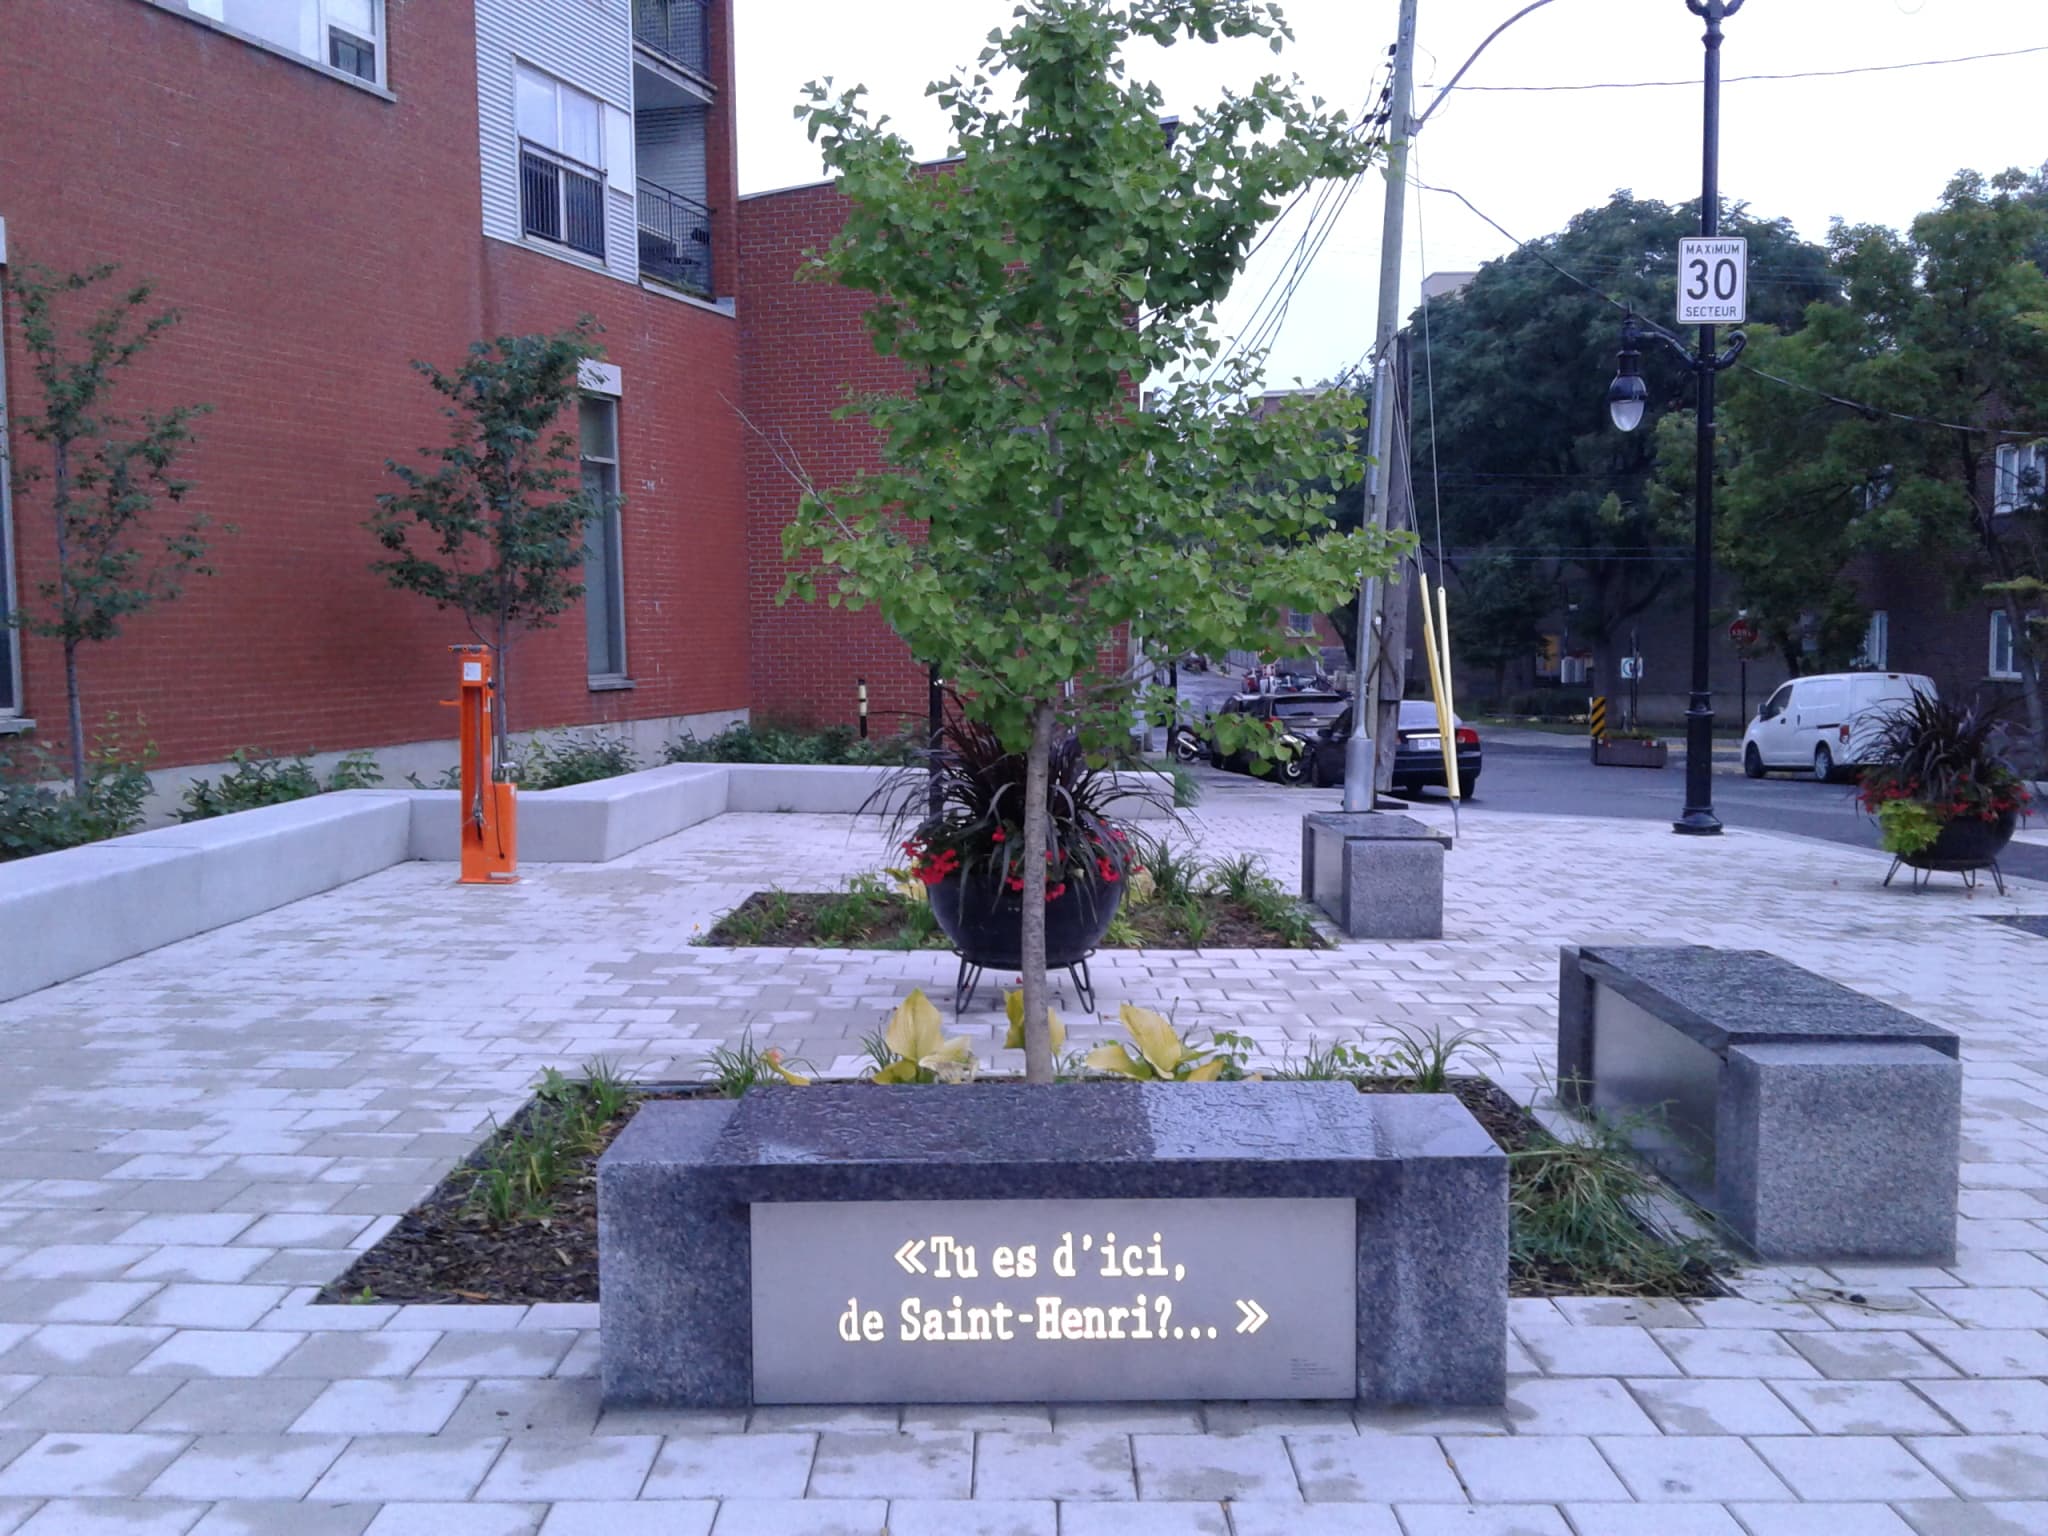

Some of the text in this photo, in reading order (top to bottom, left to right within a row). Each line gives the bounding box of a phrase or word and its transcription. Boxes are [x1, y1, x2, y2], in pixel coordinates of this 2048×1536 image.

[1686, 244, 1740, 255] MAXIMUM
[1687, 258, 1737, 300] 30
[1686, 306, 1737, 317] SECTEUR
[992, 1244, 1037, 1278] es
[838, 1297, 884, 1342] de
[900, 1293, 1217, 1341] Saint-Henri?...
